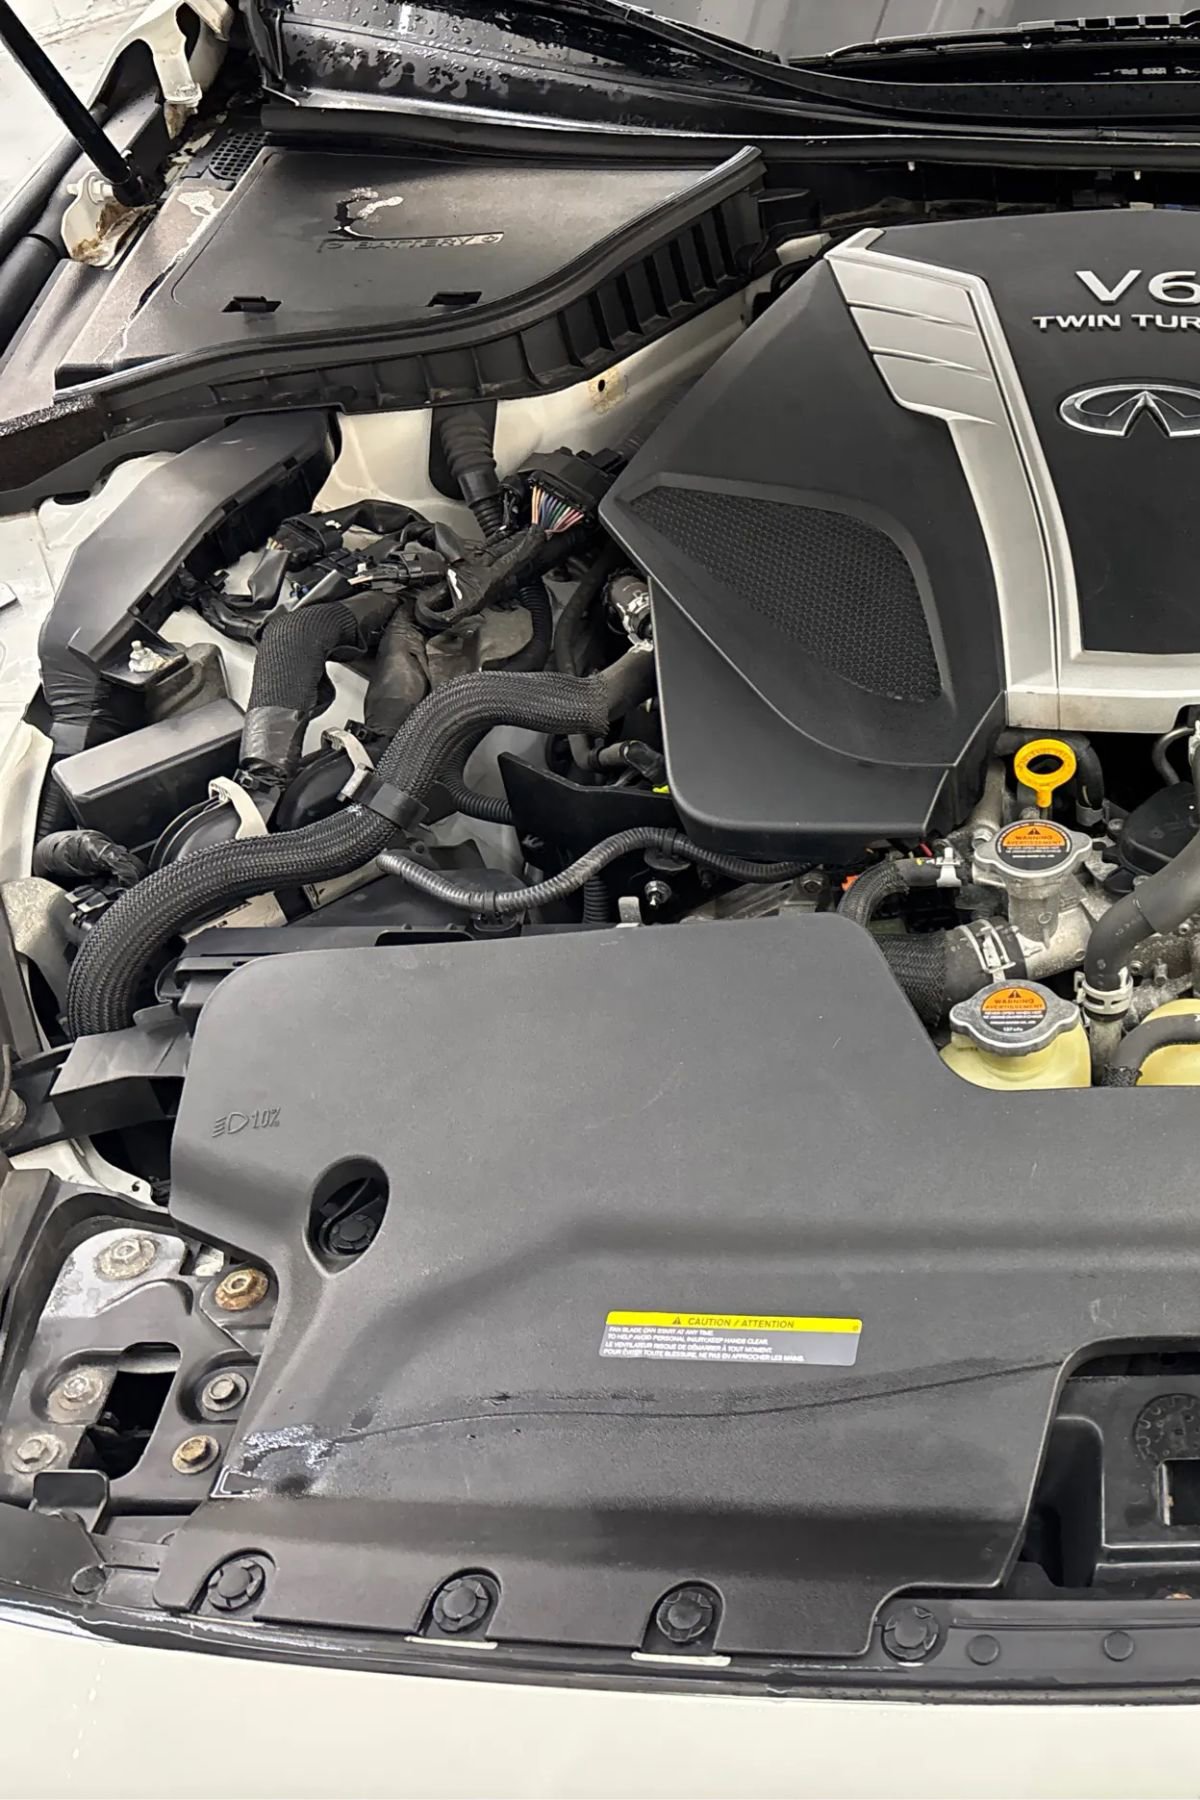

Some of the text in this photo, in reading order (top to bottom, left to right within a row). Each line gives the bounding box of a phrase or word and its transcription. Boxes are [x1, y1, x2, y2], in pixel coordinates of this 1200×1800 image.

[1032, 314, 1121, 329] TWIN
[688, 1318, 732, 1327] CAUTION
[742, 1319, 794, 1329] ATTENTION
